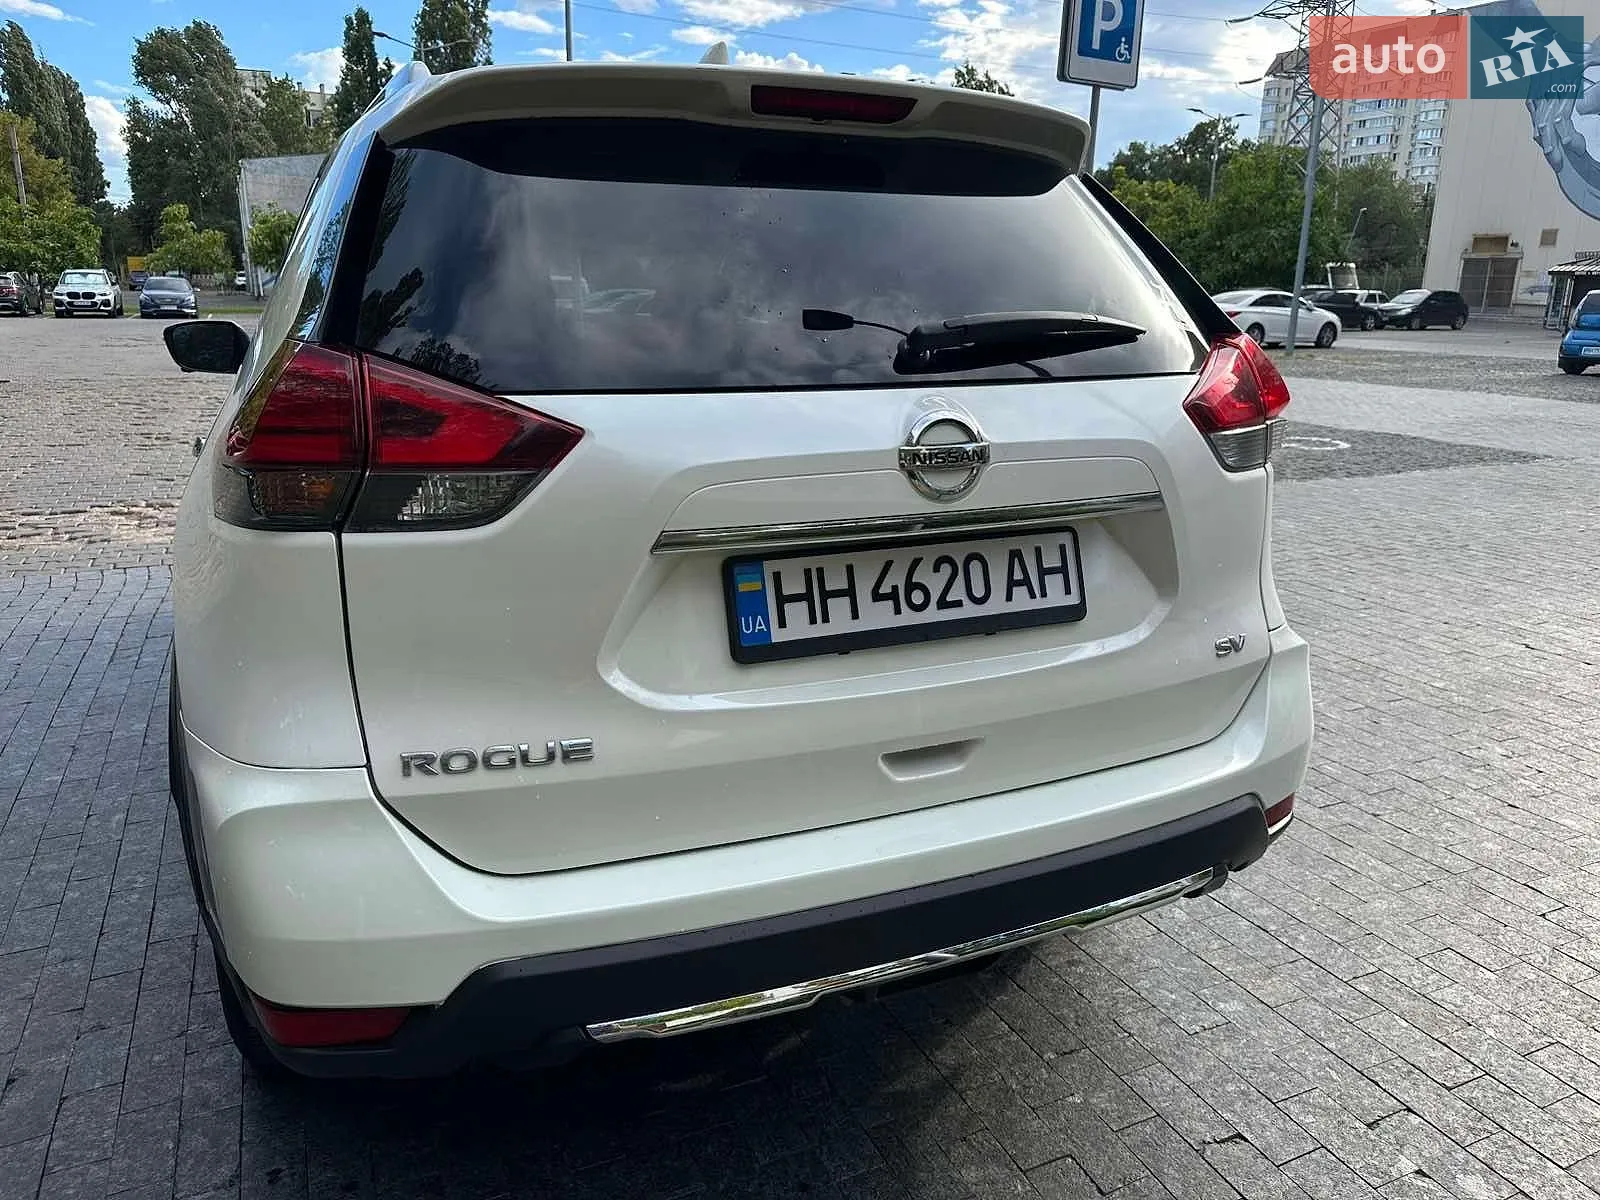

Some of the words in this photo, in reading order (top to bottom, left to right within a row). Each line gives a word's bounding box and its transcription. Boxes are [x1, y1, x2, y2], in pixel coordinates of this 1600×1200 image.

[1092, 0, 1124, 50] P
[911, 447, 984, 465] NISSAN
[772, 563, 860, 629] HH
[871, 551, 992, 615] 4620
[1005, 543, 1072, 602] AH
[741, 615, 768, 635] UA
[1215, 633, 1246, 658] SV
[399, 737, 594, 777] ROGUE
